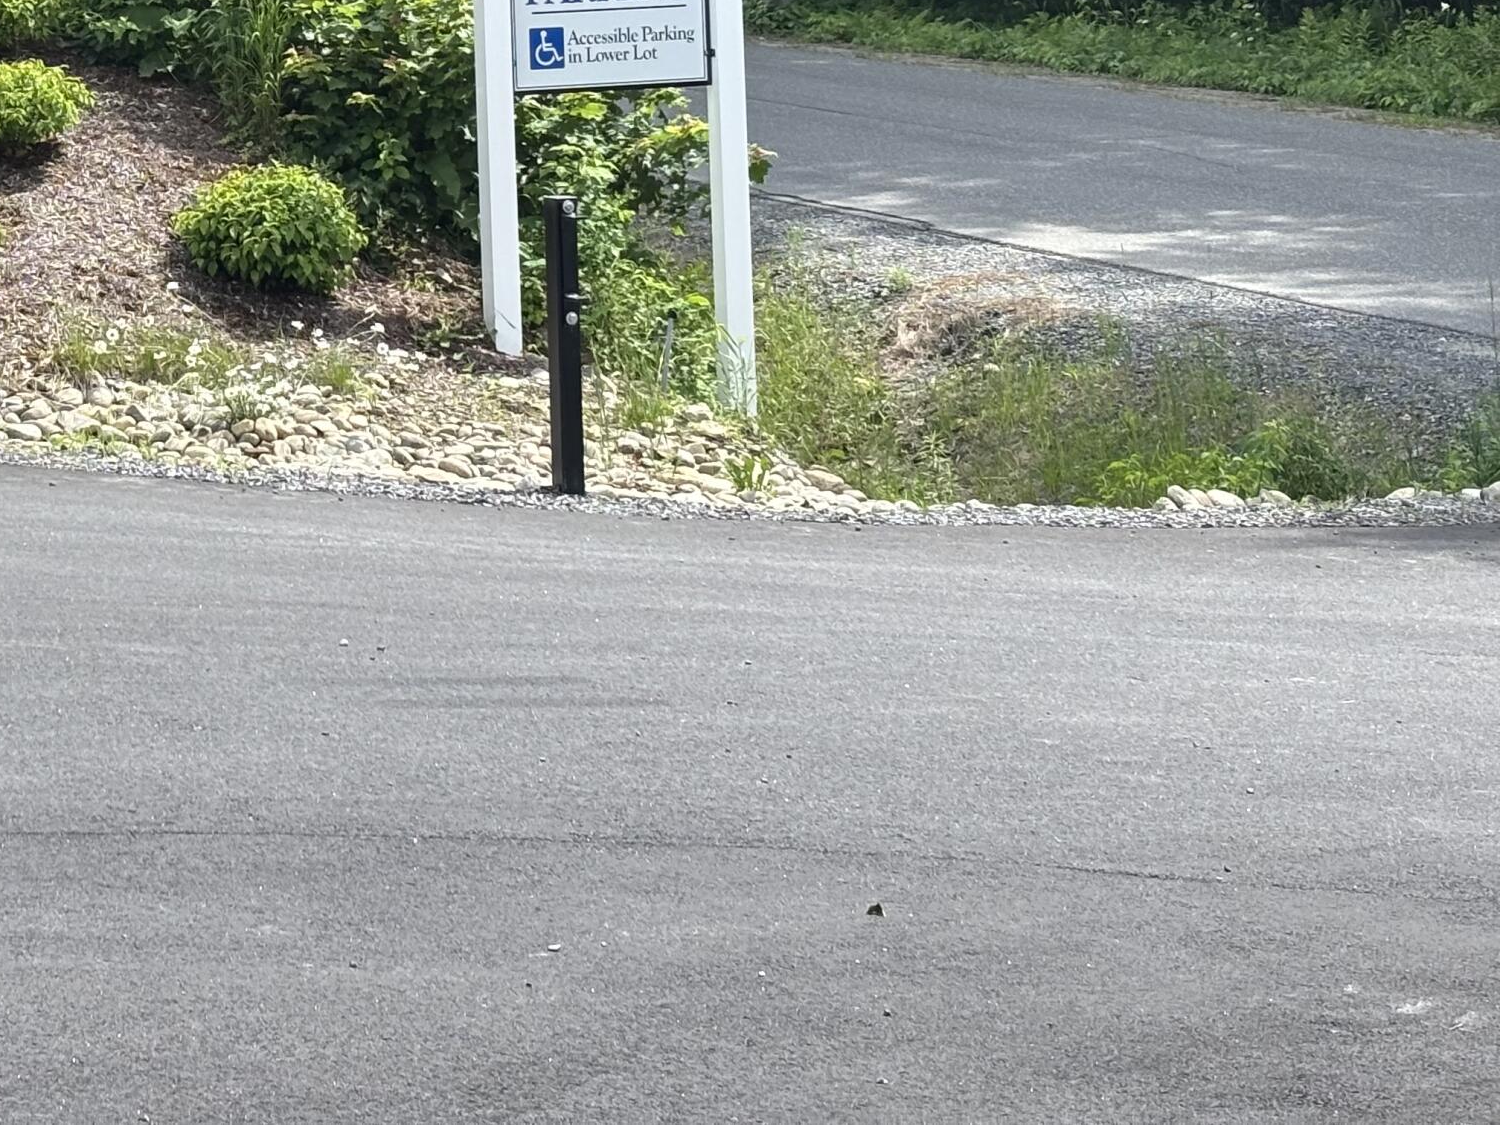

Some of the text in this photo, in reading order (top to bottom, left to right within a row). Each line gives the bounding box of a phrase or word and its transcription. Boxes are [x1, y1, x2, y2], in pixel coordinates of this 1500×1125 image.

[567, 25, 695, 46] Accessible Parking
[568, 45, 658, 64] in Lower Lot
